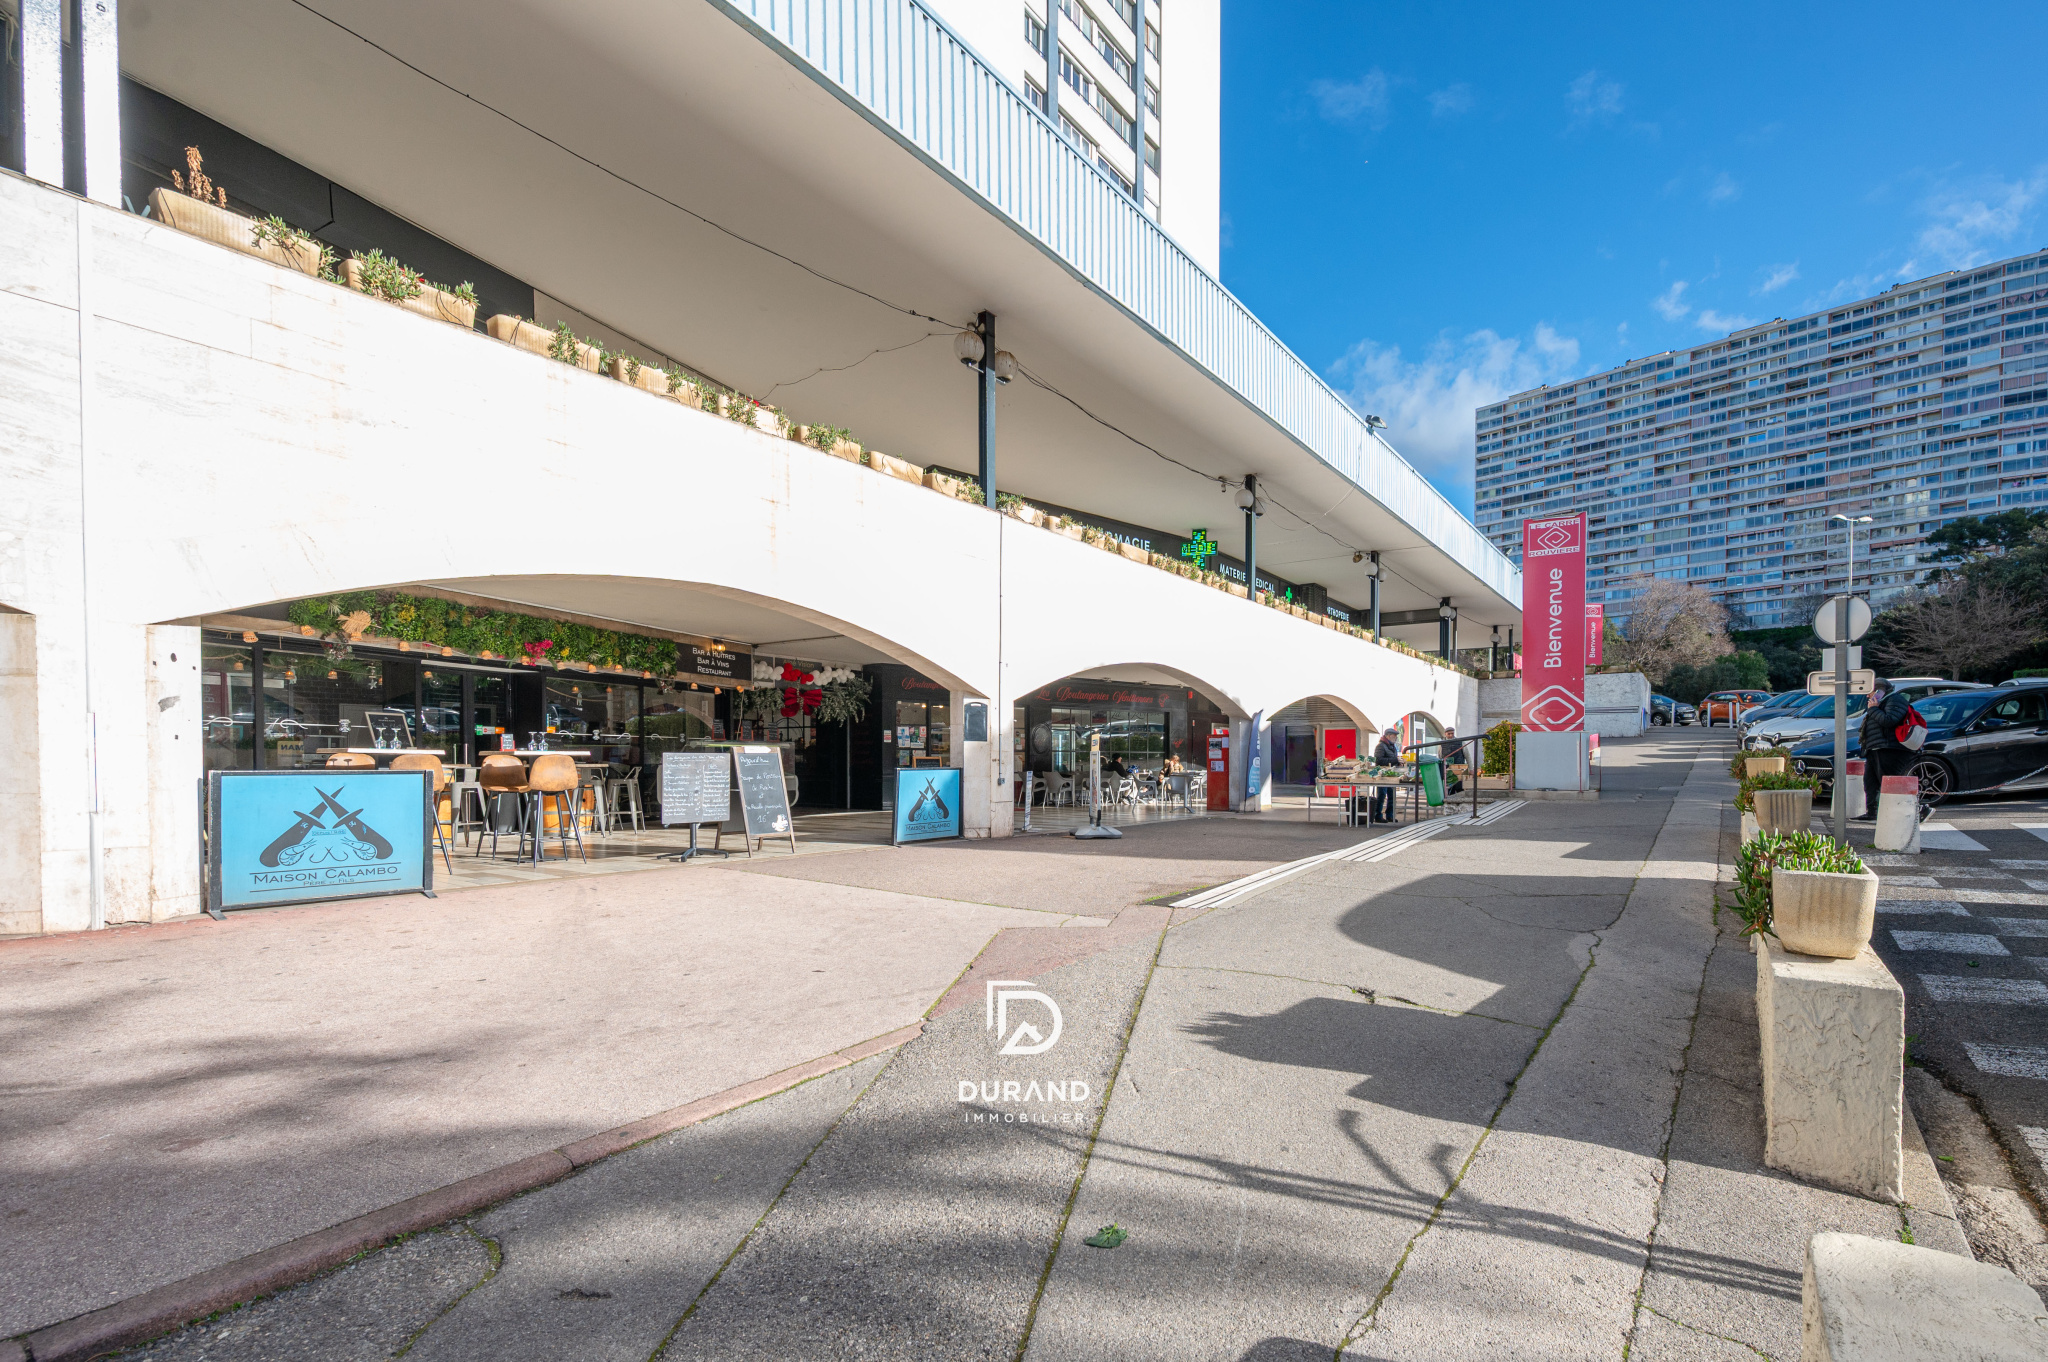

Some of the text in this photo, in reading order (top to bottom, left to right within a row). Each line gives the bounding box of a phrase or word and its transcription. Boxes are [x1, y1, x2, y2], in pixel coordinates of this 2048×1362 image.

[1102, 530, 1151, 552] RMACIE
[1219, 563, 1275, 593] MATERIE EDICAL
[1326, 606, 1350, 622] RTHOPEDIE
[1543, 567, 1563, 668] Bienvenue
[1588, 621, 1597, 659] Bienvenue
[697, 666, 732, 677] RESTAURANT
[1056, 686, 1110, 703] Boulangeries
[254, 866, 398, 885] MAISON CALAMBO
